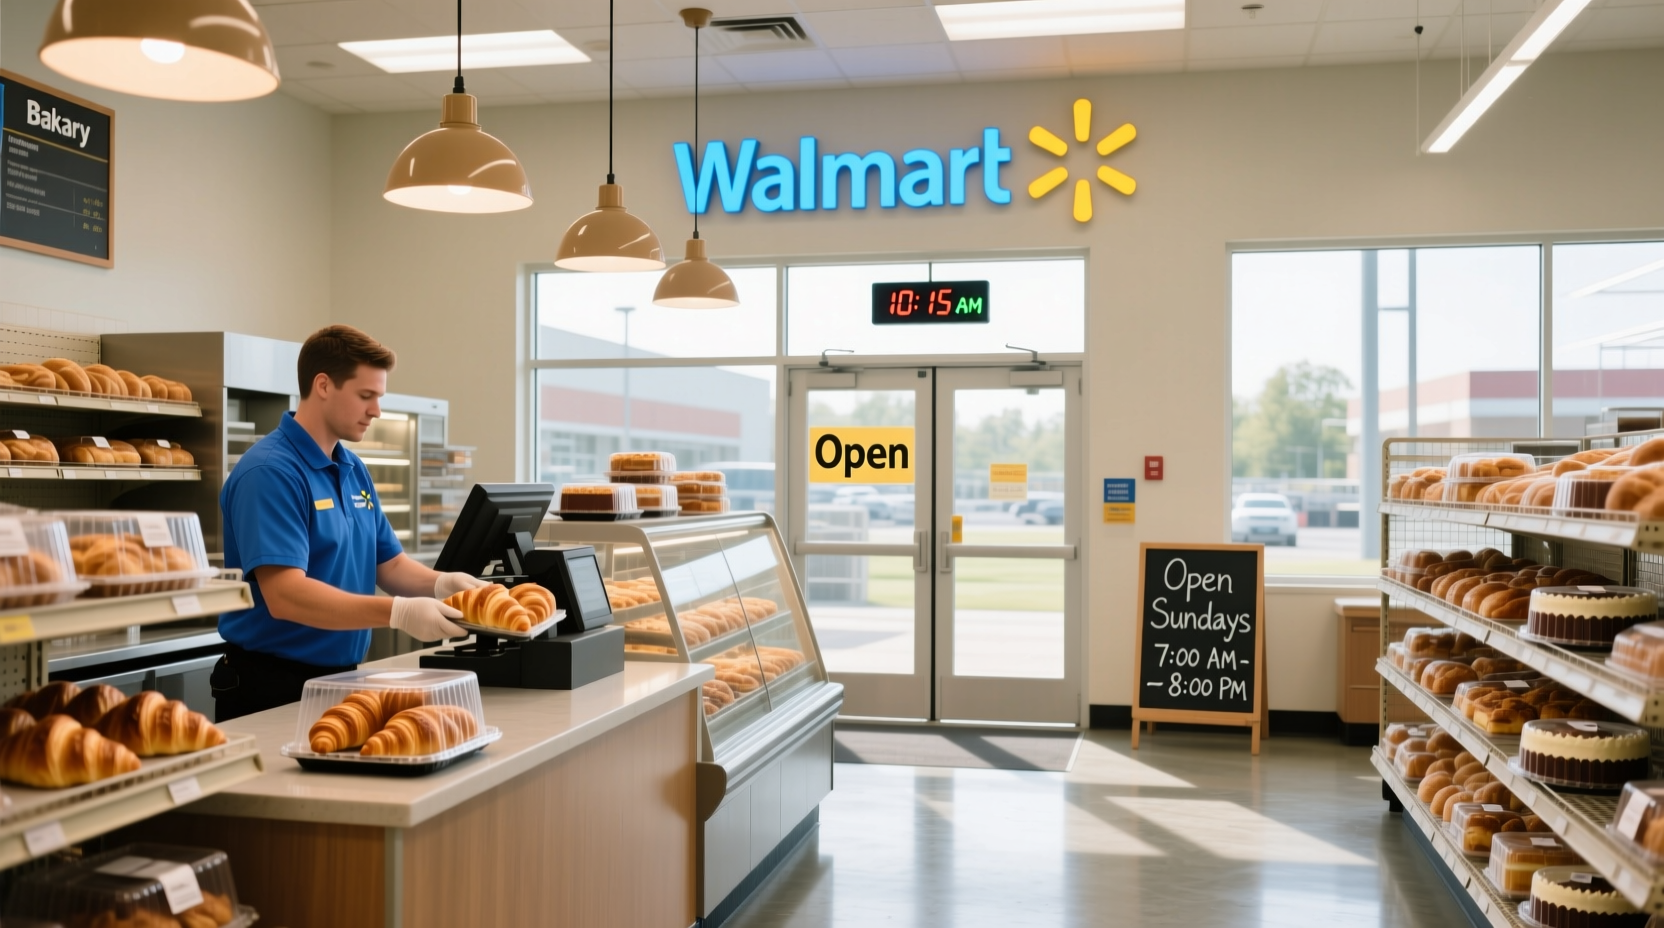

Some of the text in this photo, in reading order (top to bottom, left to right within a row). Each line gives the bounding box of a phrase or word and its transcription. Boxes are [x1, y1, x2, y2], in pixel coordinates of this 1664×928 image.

[26, 98, 91, 148] Bakary
[673, 126, 1012, 214] Walmart
[889, 288, 983, 316] 10:15 AM
[815, 433, 909, 478] Open
[1164, 557, 1233, 602] Open
[1150, 596, 1251, 642] Sundays
[1154, 643, 1200, 668] 7:00
[1219, 676, 1247, 701] PM
